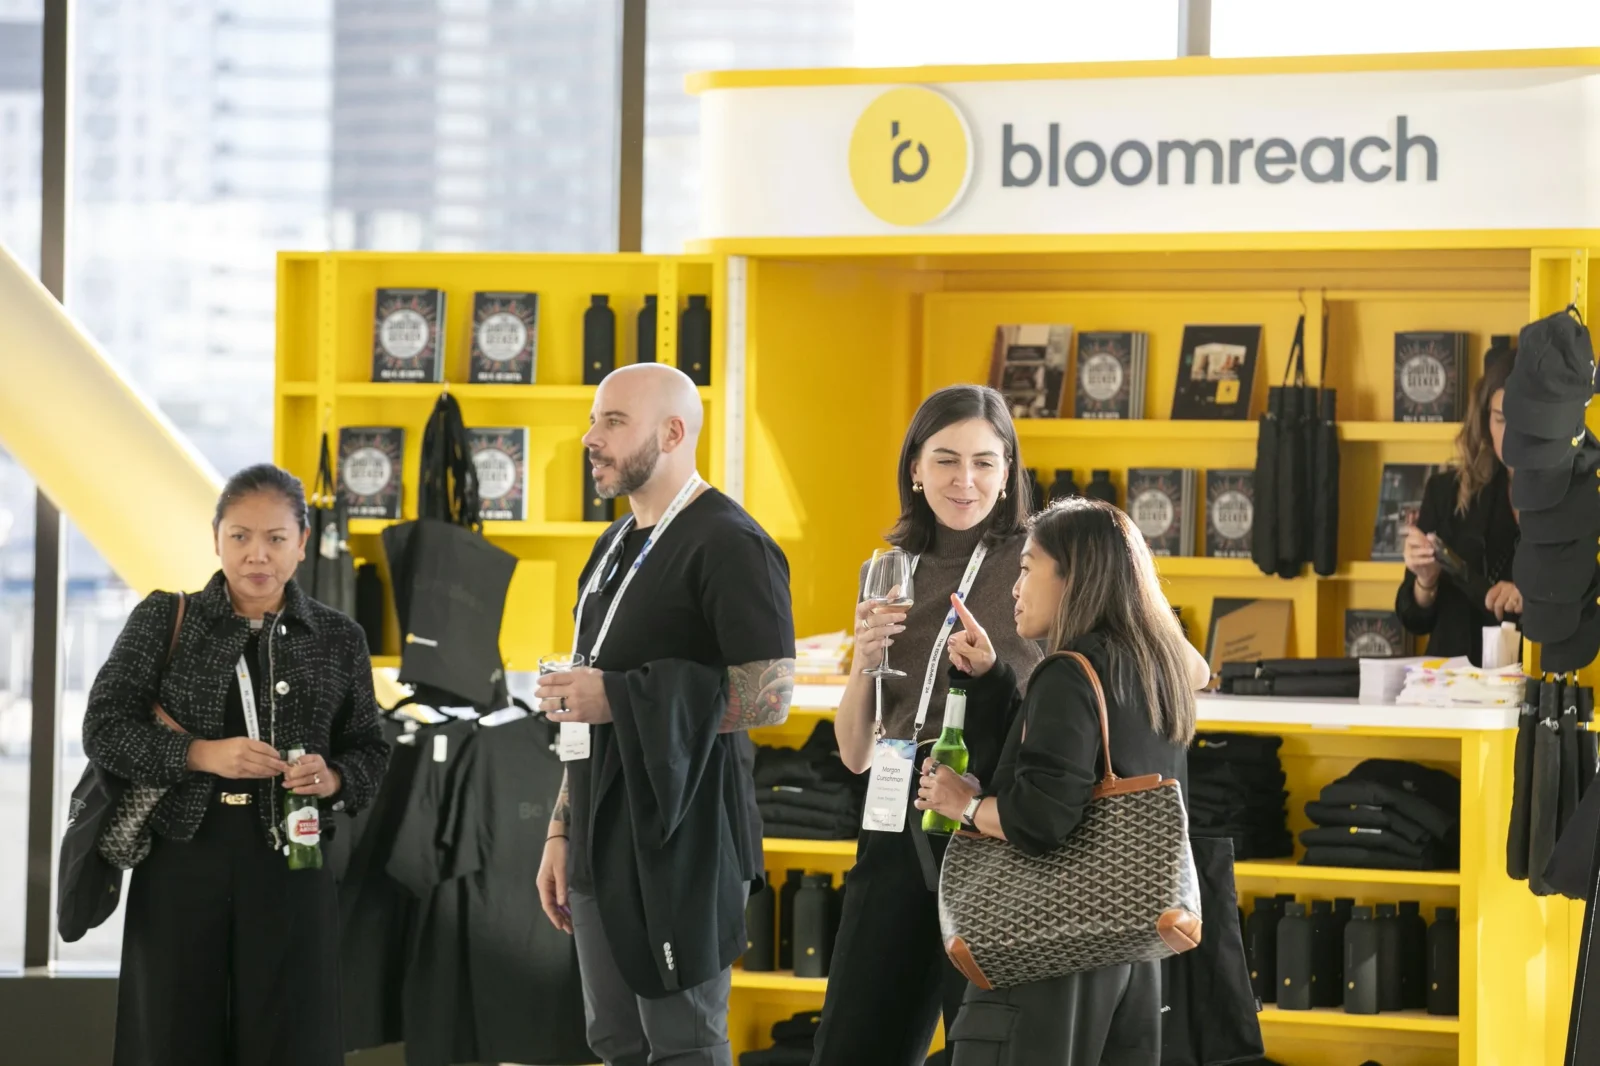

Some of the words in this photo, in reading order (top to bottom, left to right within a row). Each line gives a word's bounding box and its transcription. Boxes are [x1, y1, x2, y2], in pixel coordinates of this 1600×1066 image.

[1001, 115, 1439, 188] bloomreach
[927, 663, 936, 685] SUMMIT
[882, 766, 901, 775] Morgan
